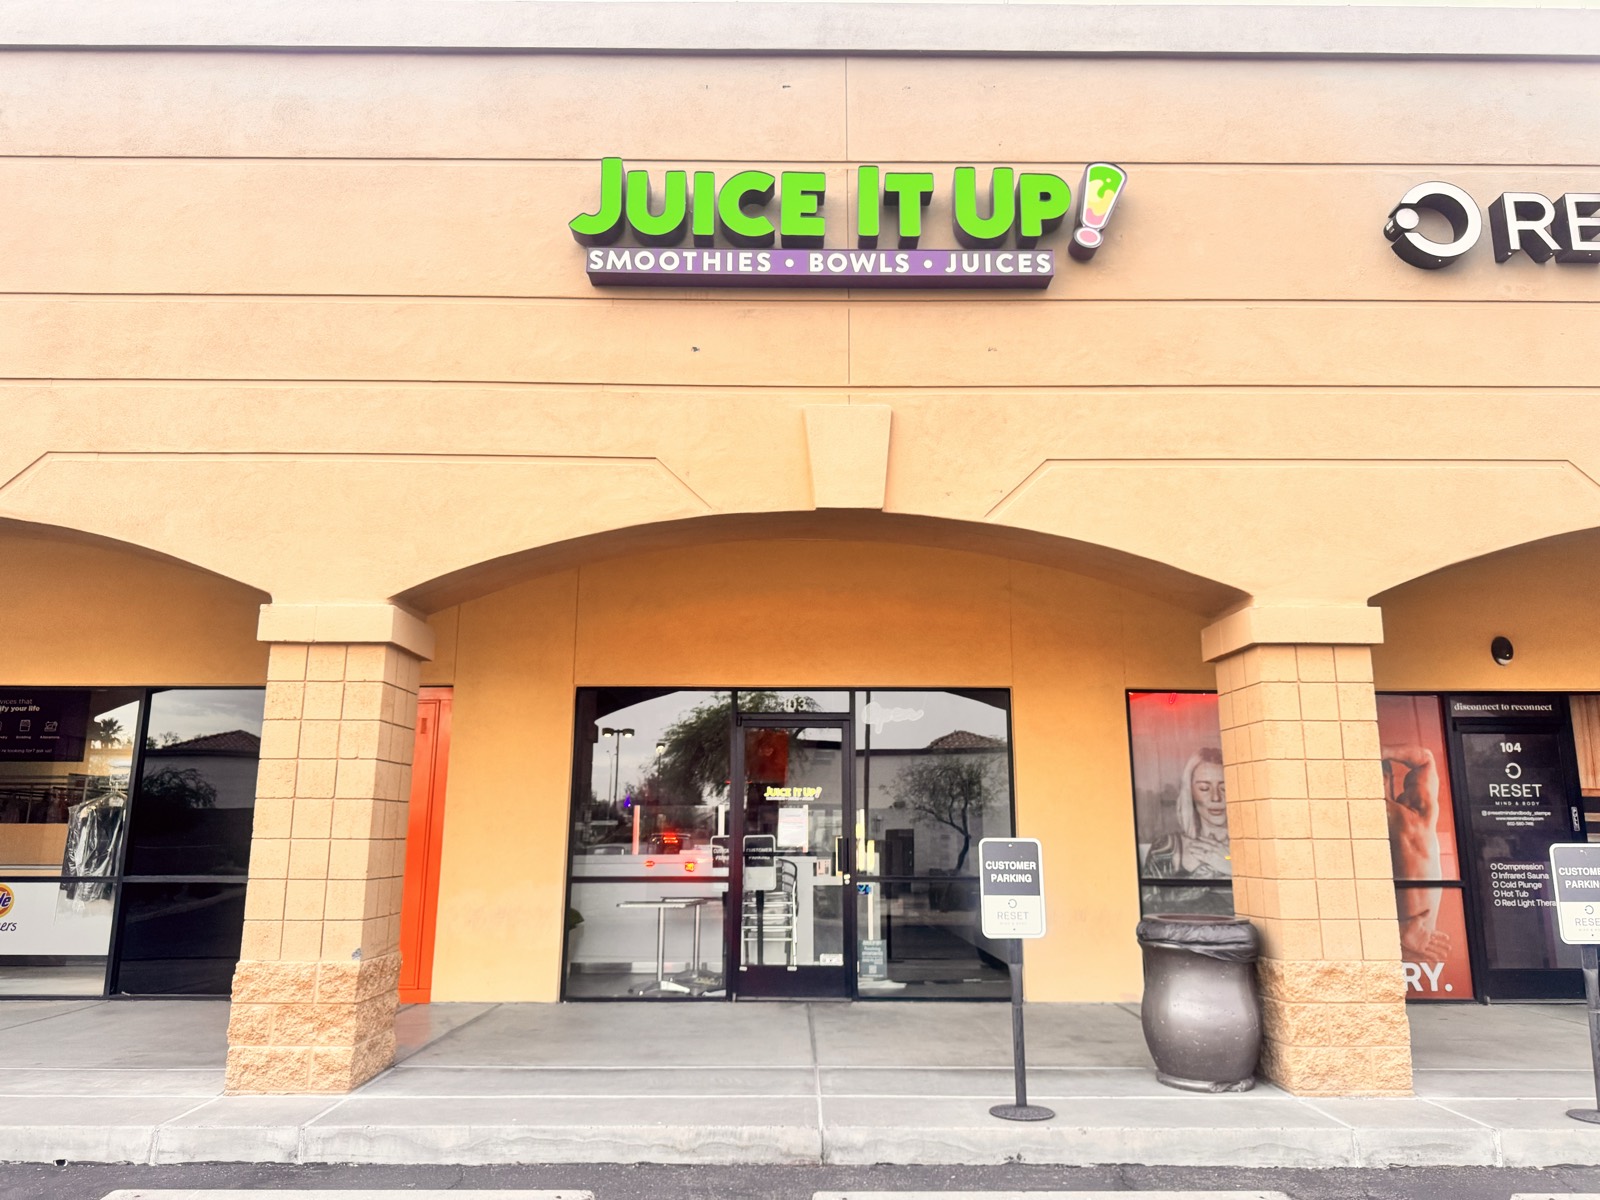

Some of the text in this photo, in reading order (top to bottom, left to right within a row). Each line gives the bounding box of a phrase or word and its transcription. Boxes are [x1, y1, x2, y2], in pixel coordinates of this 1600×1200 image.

[567, 156, 827, 238] JUICE
[857, 164, 935, 238] IT
[588, 249, 1052, 274] SMOOTHIES BOWLS JUICES
[1453, 702, 1553, 711] disconnect to reconnect
[1500, 742, 1522, 753] 104
[1488, 783, 1543, 798] RESET
[985, 860, 1037, 870] CUSTOMER
[1497, 862, 1545, 871] Compression
[990, 873, 1033, 883] PARKING
[1498, 871, 1550, 880] Infrared Sauna
[1499, 881, 1543, 890] Cold Plunge
[1565, 879, 1600, 889] PARKIN
[1500, 890, 1529, 898] Hot Tub
[1501, 899, 1516, 907] Red
[1517, 899, 1535, 909] Light
[997, 911, 1029, 921] RESET
